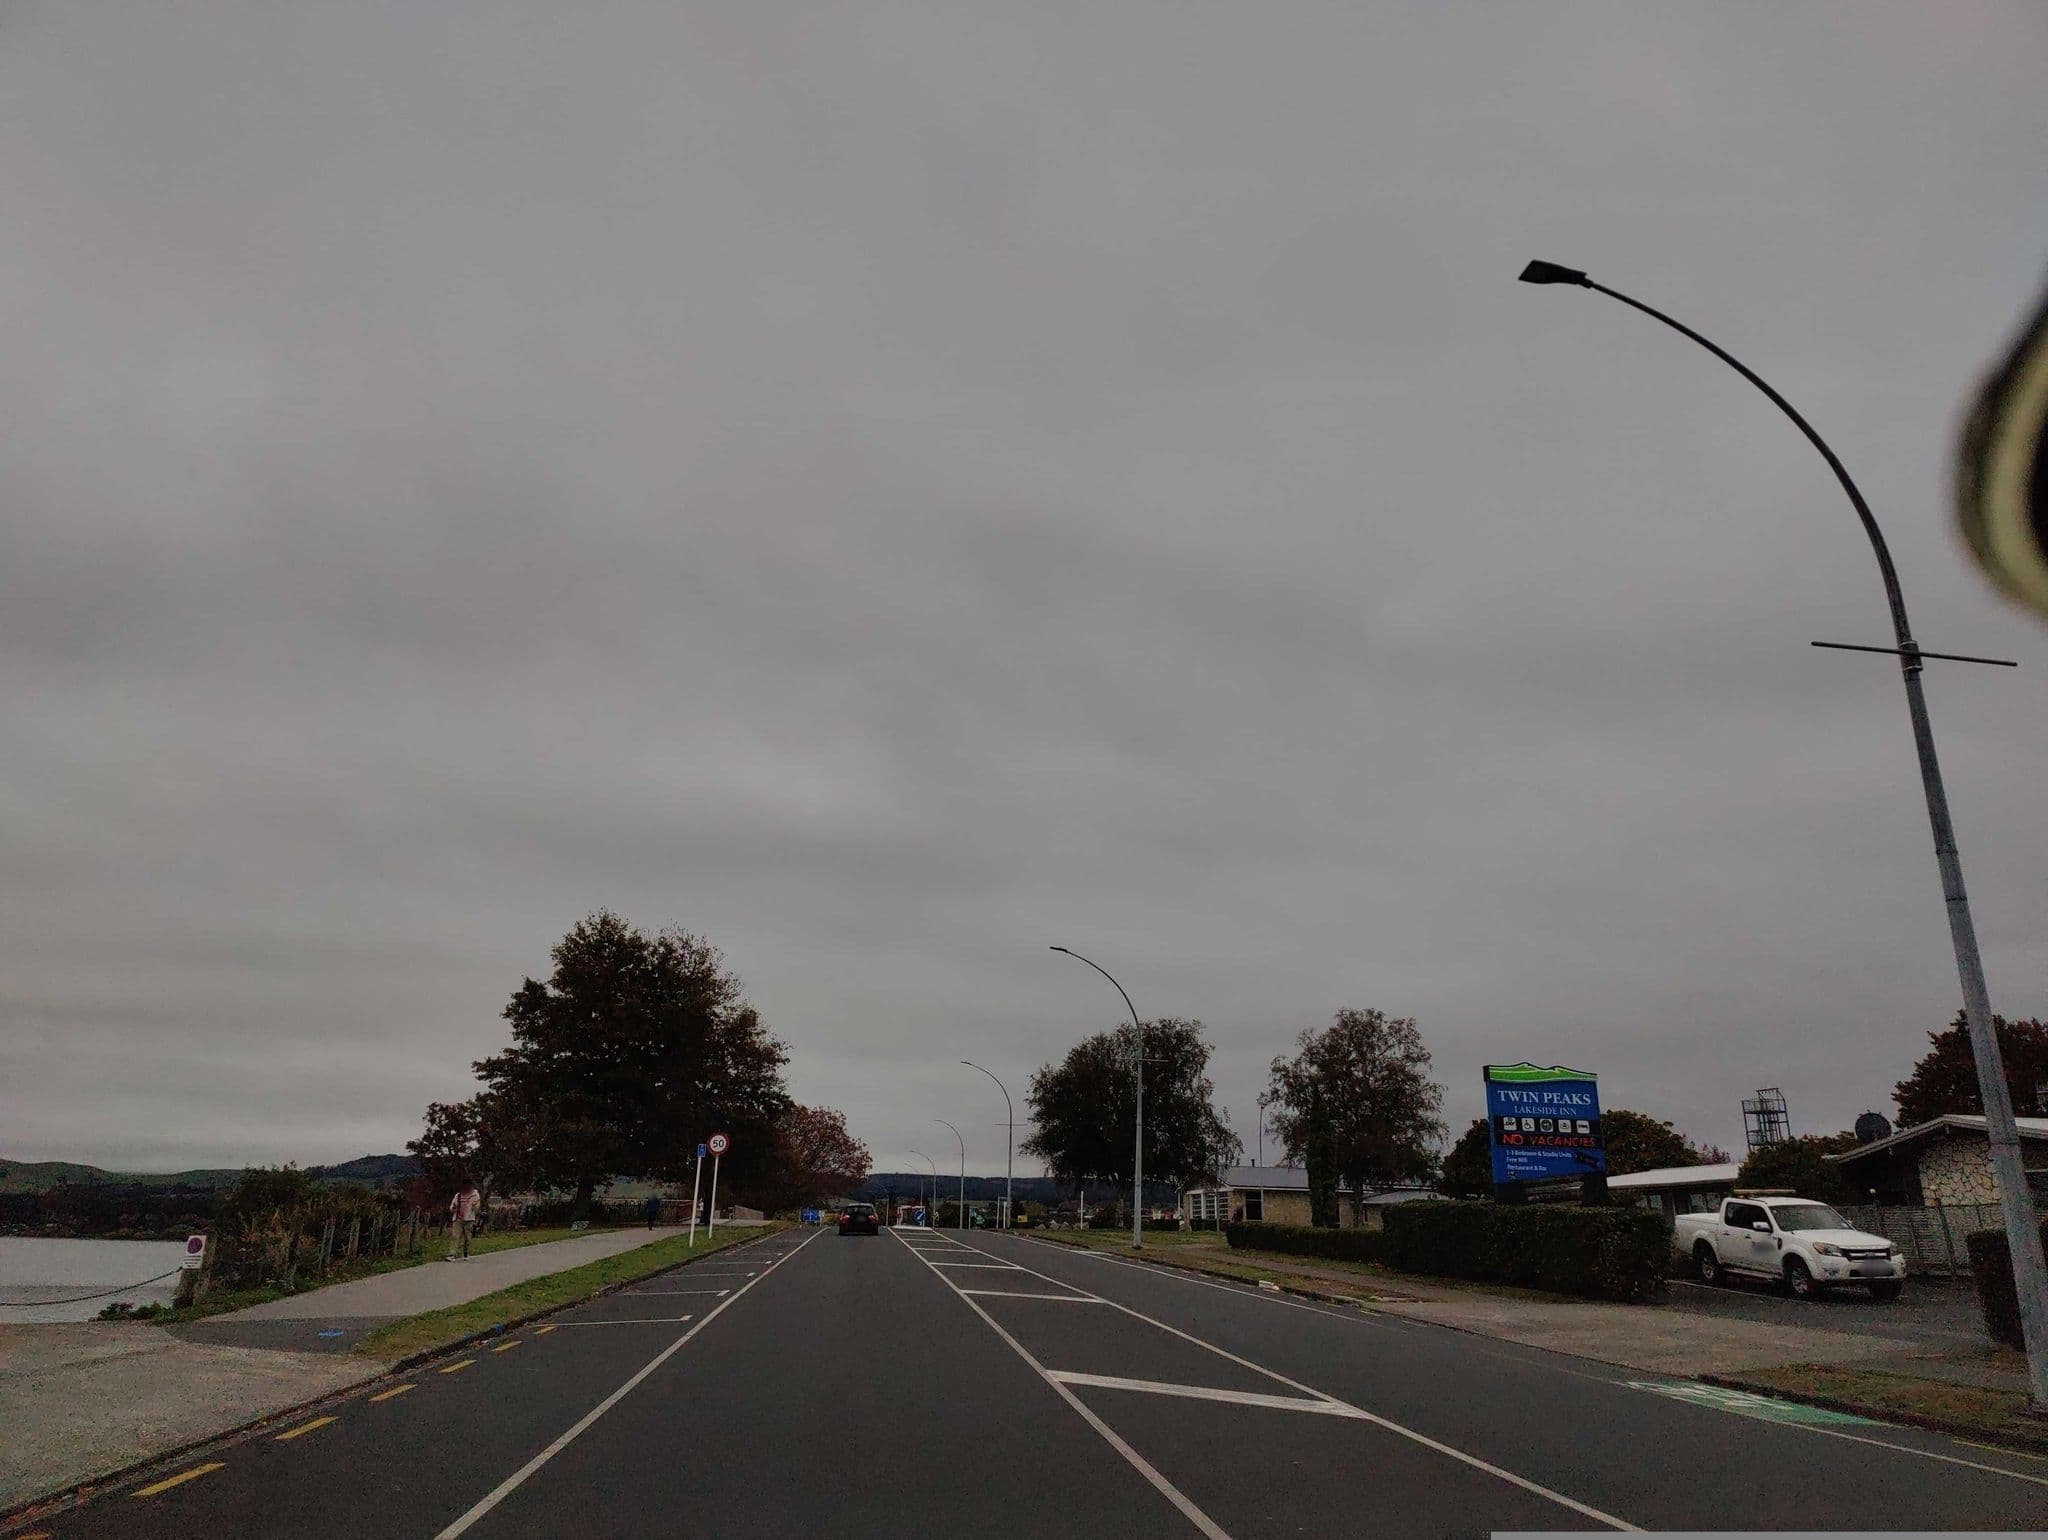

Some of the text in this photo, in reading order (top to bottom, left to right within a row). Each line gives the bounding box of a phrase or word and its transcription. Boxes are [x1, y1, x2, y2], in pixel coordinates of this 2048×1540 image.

[1497, 1090, 1591, 1105] TWIN PEAKS
[1514, 1105, 1577, 1116] LAKESIDE INN
[712, 1139, 725, 1148] 50
[1503, 1134, 1596, 1147] NO VACANCIES
